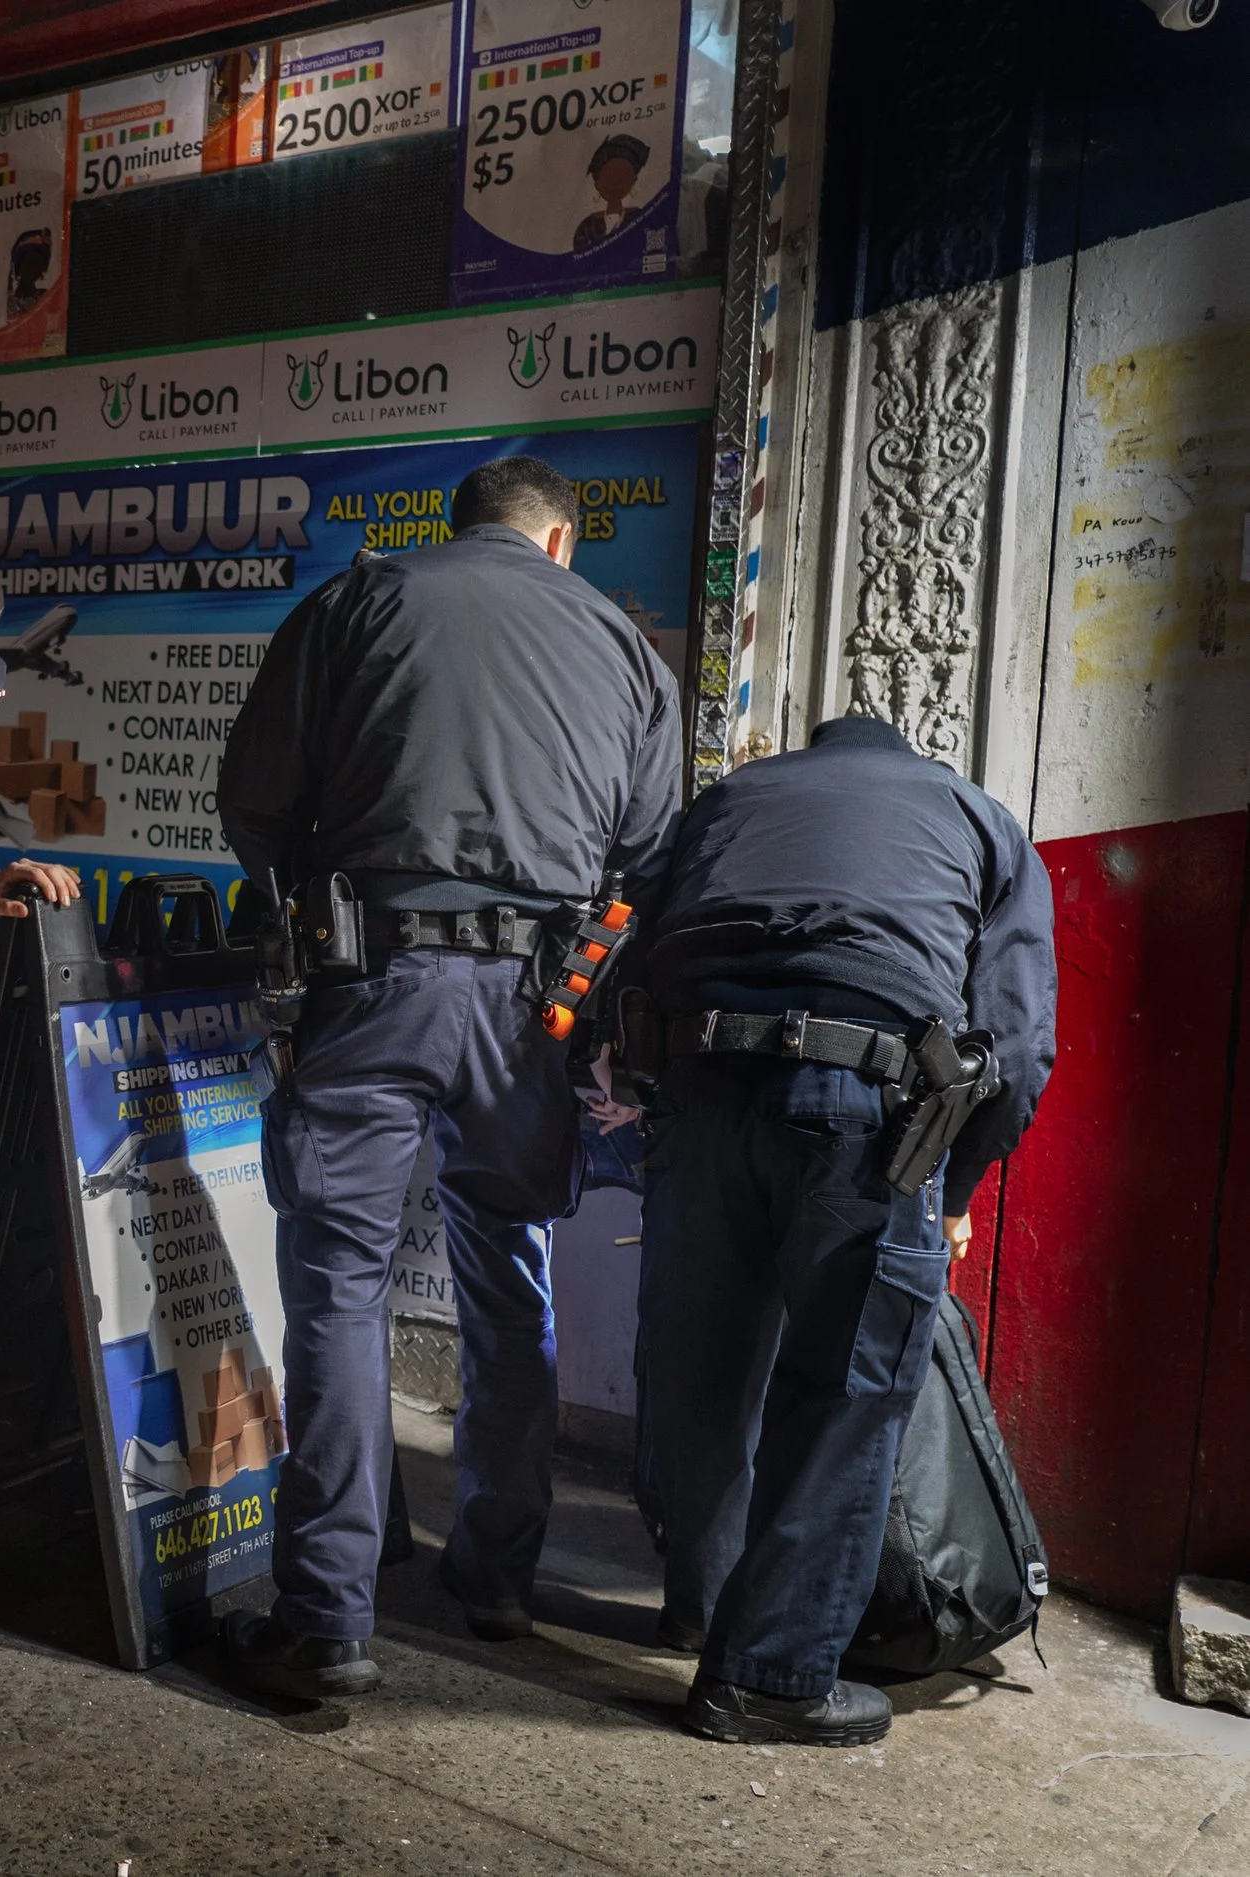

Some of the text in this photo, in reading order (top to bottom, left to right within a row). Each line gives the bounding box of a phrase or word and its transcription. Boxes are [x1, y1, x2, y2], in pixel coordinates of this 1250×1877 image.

[292, 44, 380, 74] International Top-up
[494, 30, 596, 62] International Top-up
[15, 107, 62, 131] Libon
[276, 97, 371, 151] 2500
[375, 86, 421, 115] XOF
[373, 123, 384, 134] or
[386, 120, 399, 135] up
[400, 117, 411, 130] to
[475, 78, 645, 146] 2500 XOF
[586, 118, 598, 129] or
[600, 115, 615, 131] up
[618, 111, 630, 125] to
[82, 140, 203, 194] 50 minutes
[472, 151, 514, 193] $5
[562, 331, 697, 380] Libon
[333, 358, 448, 402] Libon
[560, 378, 695, 403] CALL PAYMENT
[140, 381, 238, 422] Libon
[332, 402, 447, 424] CALL PAYMENT
[139, 422, 238, 442] CALL PAYMENT
[6, 439, 56, 454] PAYMENT
[325, 494, 366, 521] ALL
[373, 489, 443, 518] YOUR
[1082, 519, 1101, 533] PA
[113, 562, 188, 591] NEW
[193, 557, 287, 589] YORK
[166, 645, 211, 668] FREE
[102, 681, 152, 704] NEXT
[158, 681, 202, 704] DAY
[121, 752, 194, 778] DAKAR
[135, 787, 181, 814] NEW
[147, 823, 212, 851] OTHER
[116, 1061, 198, 1092] SHIPPING
[202, 1055, 237, 1079] NEW
[118, 1100, 141, 1122] ALL
[145, 1093, 185, 1115] YOUR
[143, 1110, 207, 1138] SHIPPING
[172, 1175, 205, 1199] FREE
[421, 1187, 439, 1213] &
[131, 1212, 169, 1239] NEXT
[171, 1205, 207, 1230] DAY
[156, 1266, 209, 1296] DAKAR
[172, 1295, 209, 1322] NEW
[186, 1321, 232, 1349] OTHER
[150, 1493, 222, 1530] PLEASE CALL MODOU:
[155, 1495, 263, 1565] 646.427.1123
[158, 1572, 172, 1590] 129
[207, 1548, 232, 1569] STREET
[239, 1540, 253, 1556] 7TH
[253, 1535, 269, 1550] AVE
